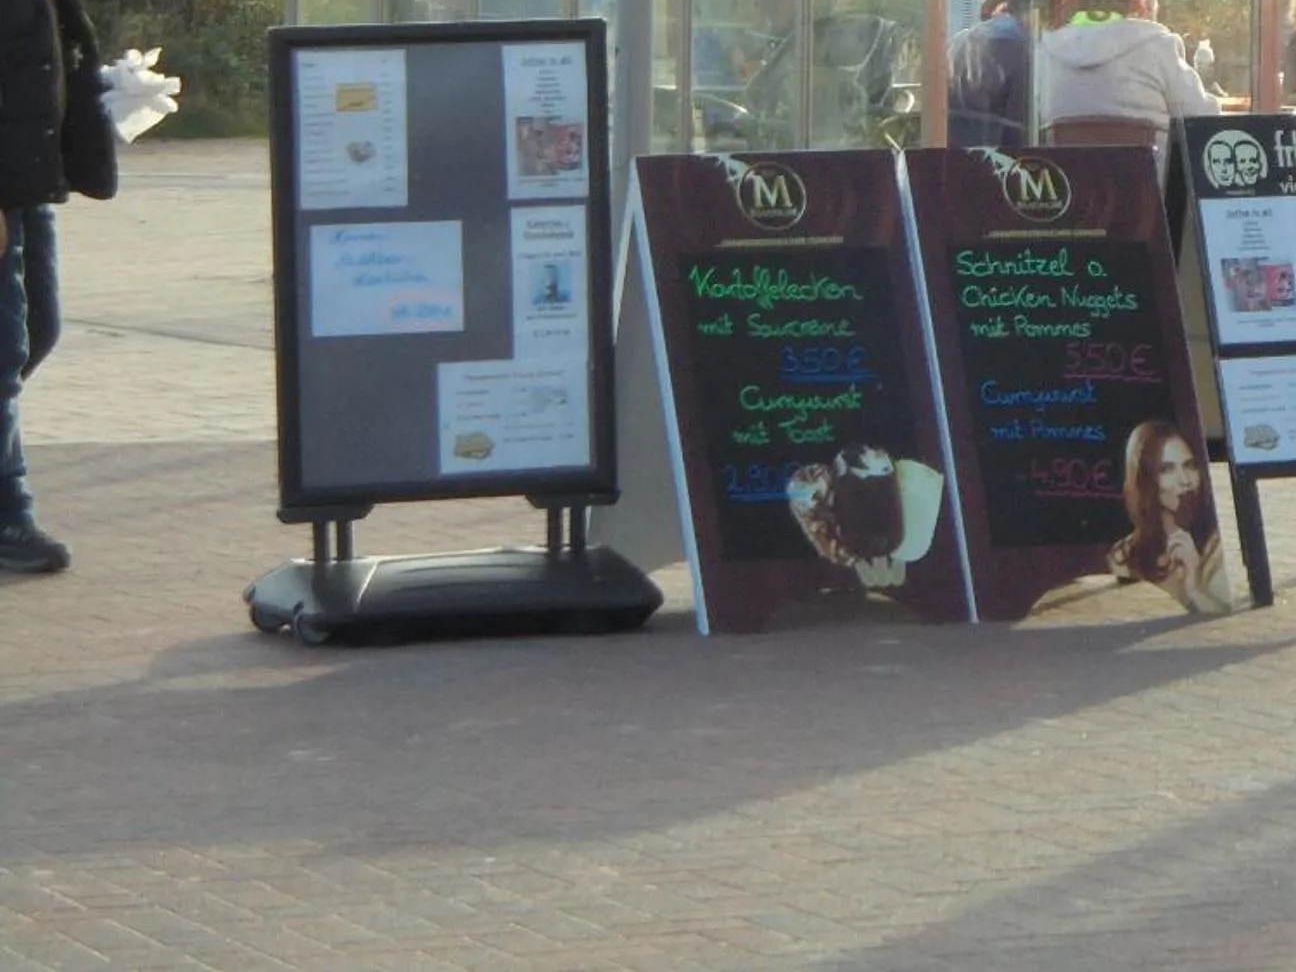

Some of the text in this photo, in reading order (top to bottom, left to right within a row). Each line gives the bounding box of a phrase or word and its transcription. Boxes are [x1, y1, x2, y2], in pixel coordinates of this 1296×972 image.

[956, 247, 1075, 277] Schnitzel
[961, 283, 1138, 318] Chicken Nuggets
[970, 314, 1092, 337] mit Pommes
